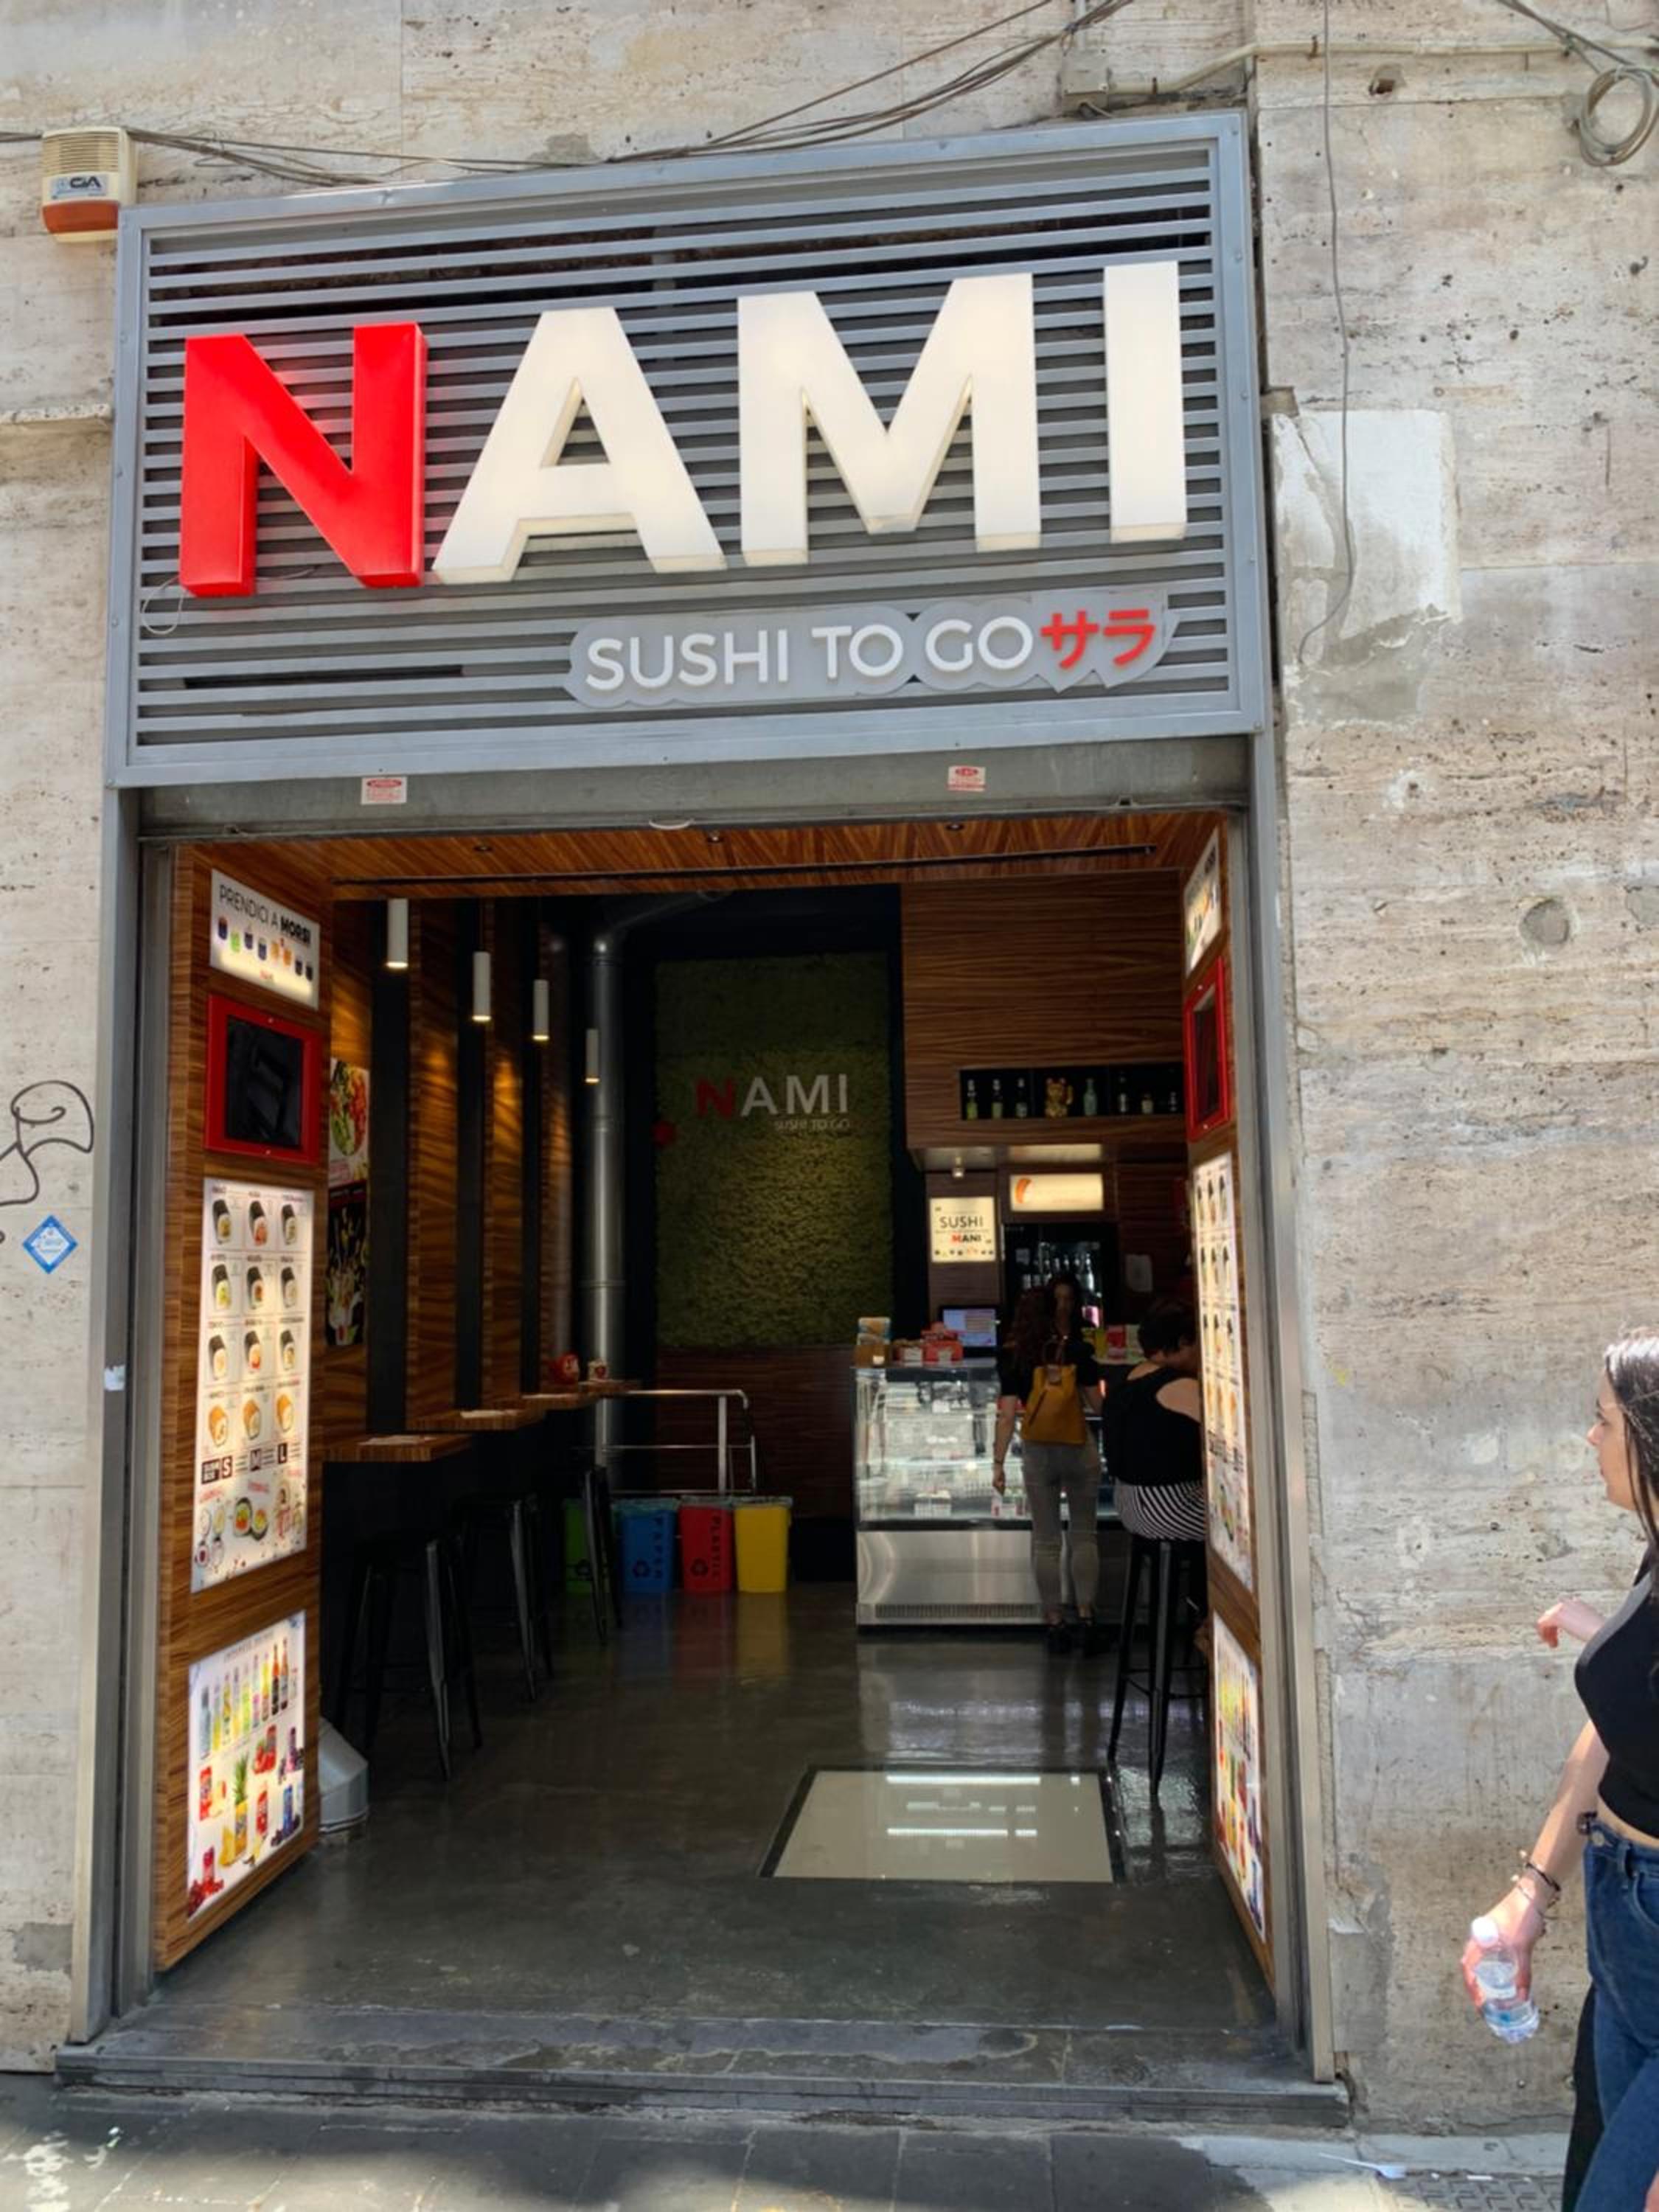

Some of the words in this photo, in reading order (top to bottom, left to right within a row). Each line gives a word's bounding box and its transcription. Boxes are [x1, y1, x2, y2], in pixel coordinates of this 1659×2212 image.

[179, 260, 1187, 597] NAMI
[586, 629, 789, 690] SUSHI
[812, 625, 903, 679] TO
[925, 616, 1032, 672] GO
[1040, 609, 1155, 669] サラ
[220, 884, 268, 923] PRENDICI
[271, 912, 279, 929] A
[281, 915, 310, 945] MORSI
[695, 1074, 847, 1120] NAMI
[939, 1215, 984, 1229] SUSHI
